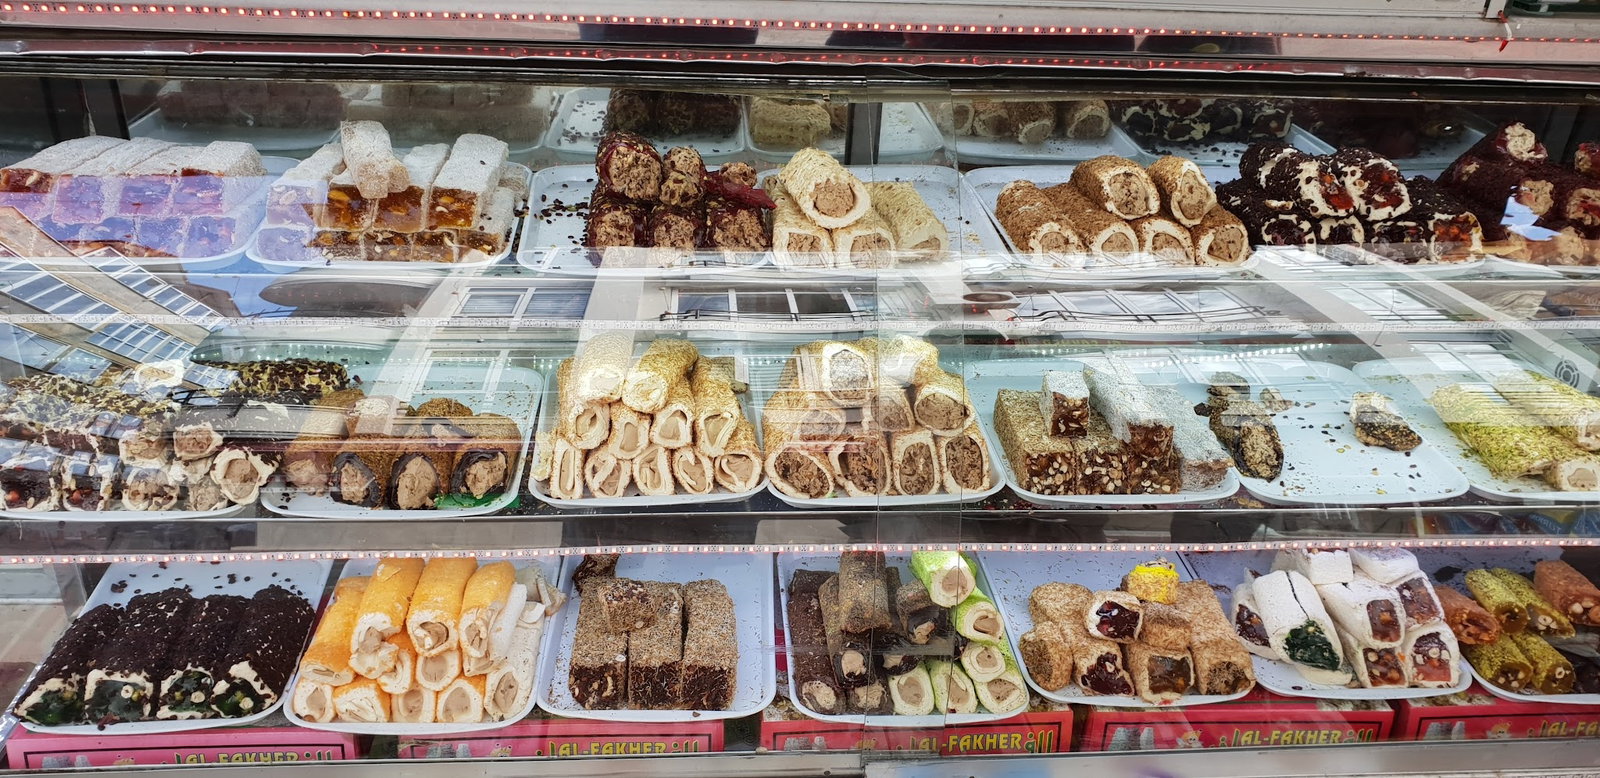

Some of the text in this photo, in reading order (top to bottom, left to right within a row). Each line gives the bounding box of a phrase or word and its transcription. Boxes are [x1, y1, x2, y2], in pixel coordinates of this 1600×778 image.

[1547, 721, 1600, 736] AL-FA
[918, 733, 1022, 752] AL-FAKHER
[1240, 729, 1342, 745] AL-FAKHER
[185, 752, 299, 763] ALFAKHER
